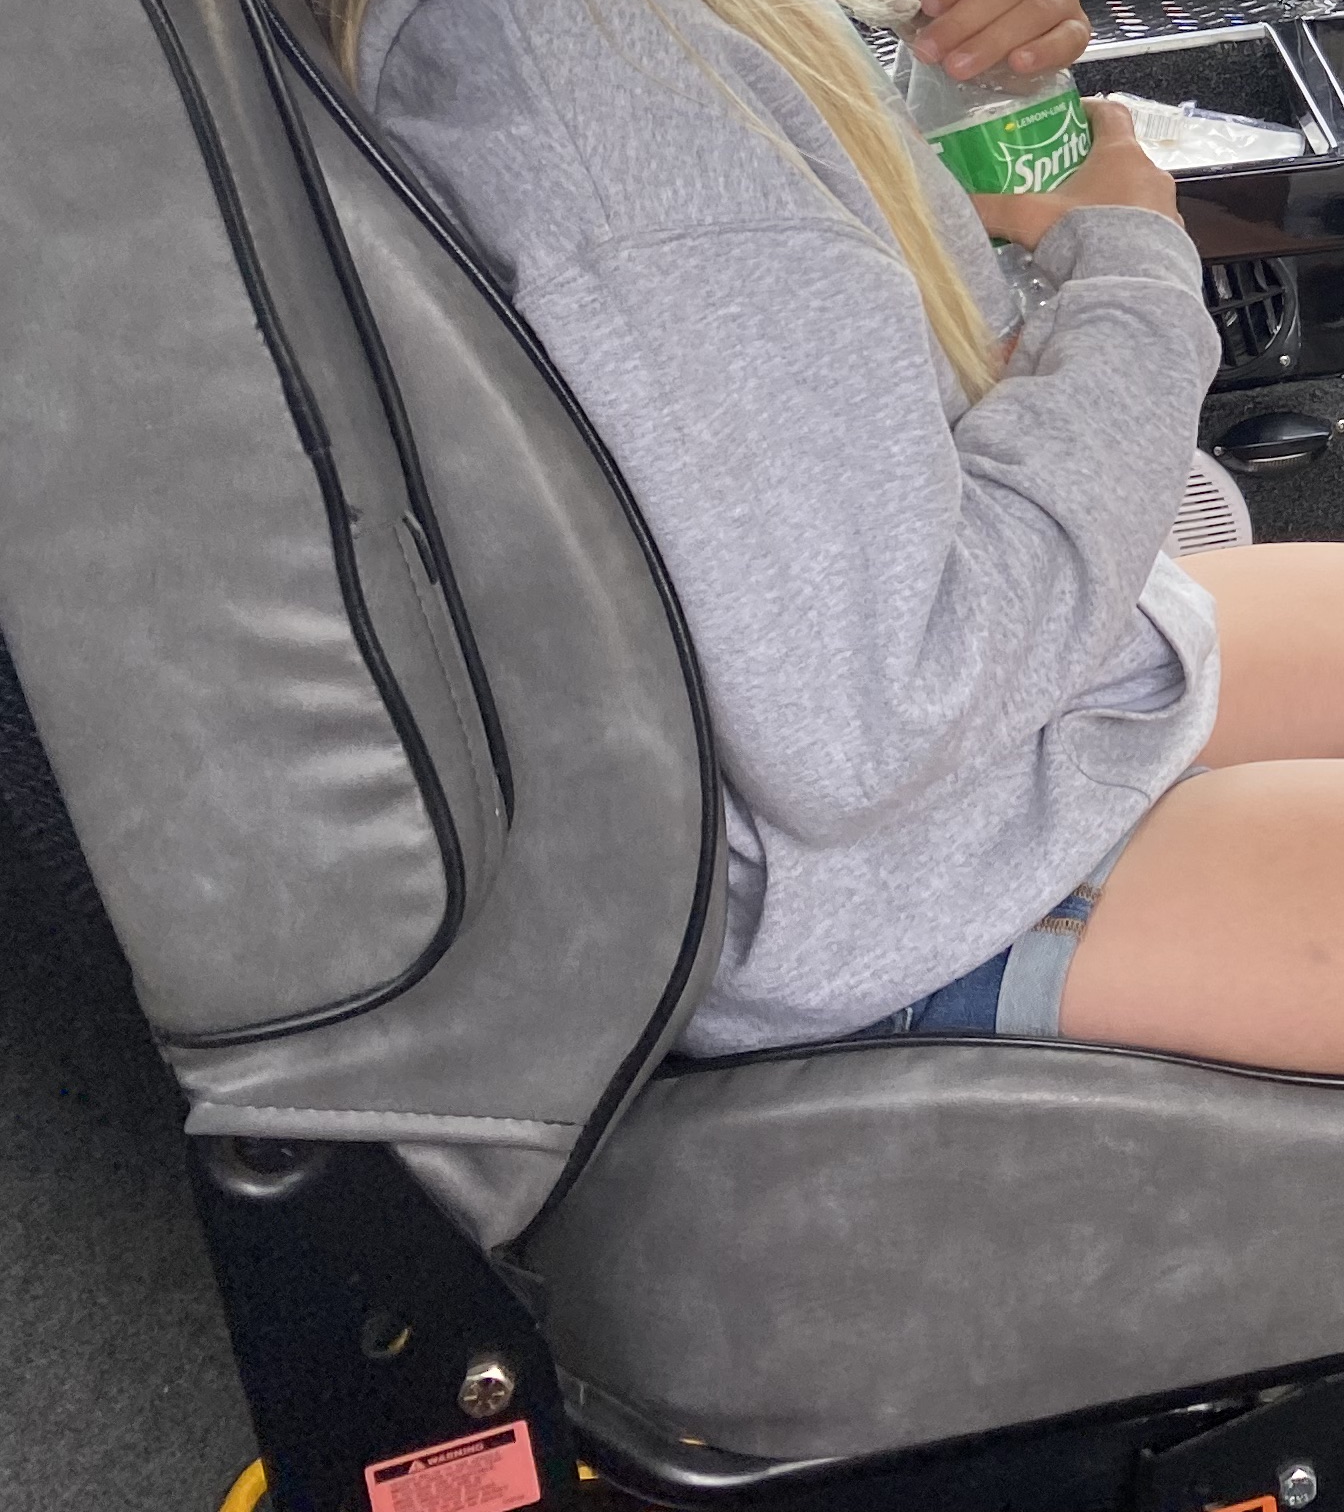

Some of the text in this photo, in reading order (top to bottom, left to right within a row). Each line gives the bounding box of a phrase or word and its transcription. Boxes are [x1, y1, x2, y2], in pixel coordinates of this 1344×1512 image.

[1016, 102, 1067, 129] LEMON-LIME
[1013, 133, 1090, 194] Sprite
[427, 1442, 484, 1466] WARNING
